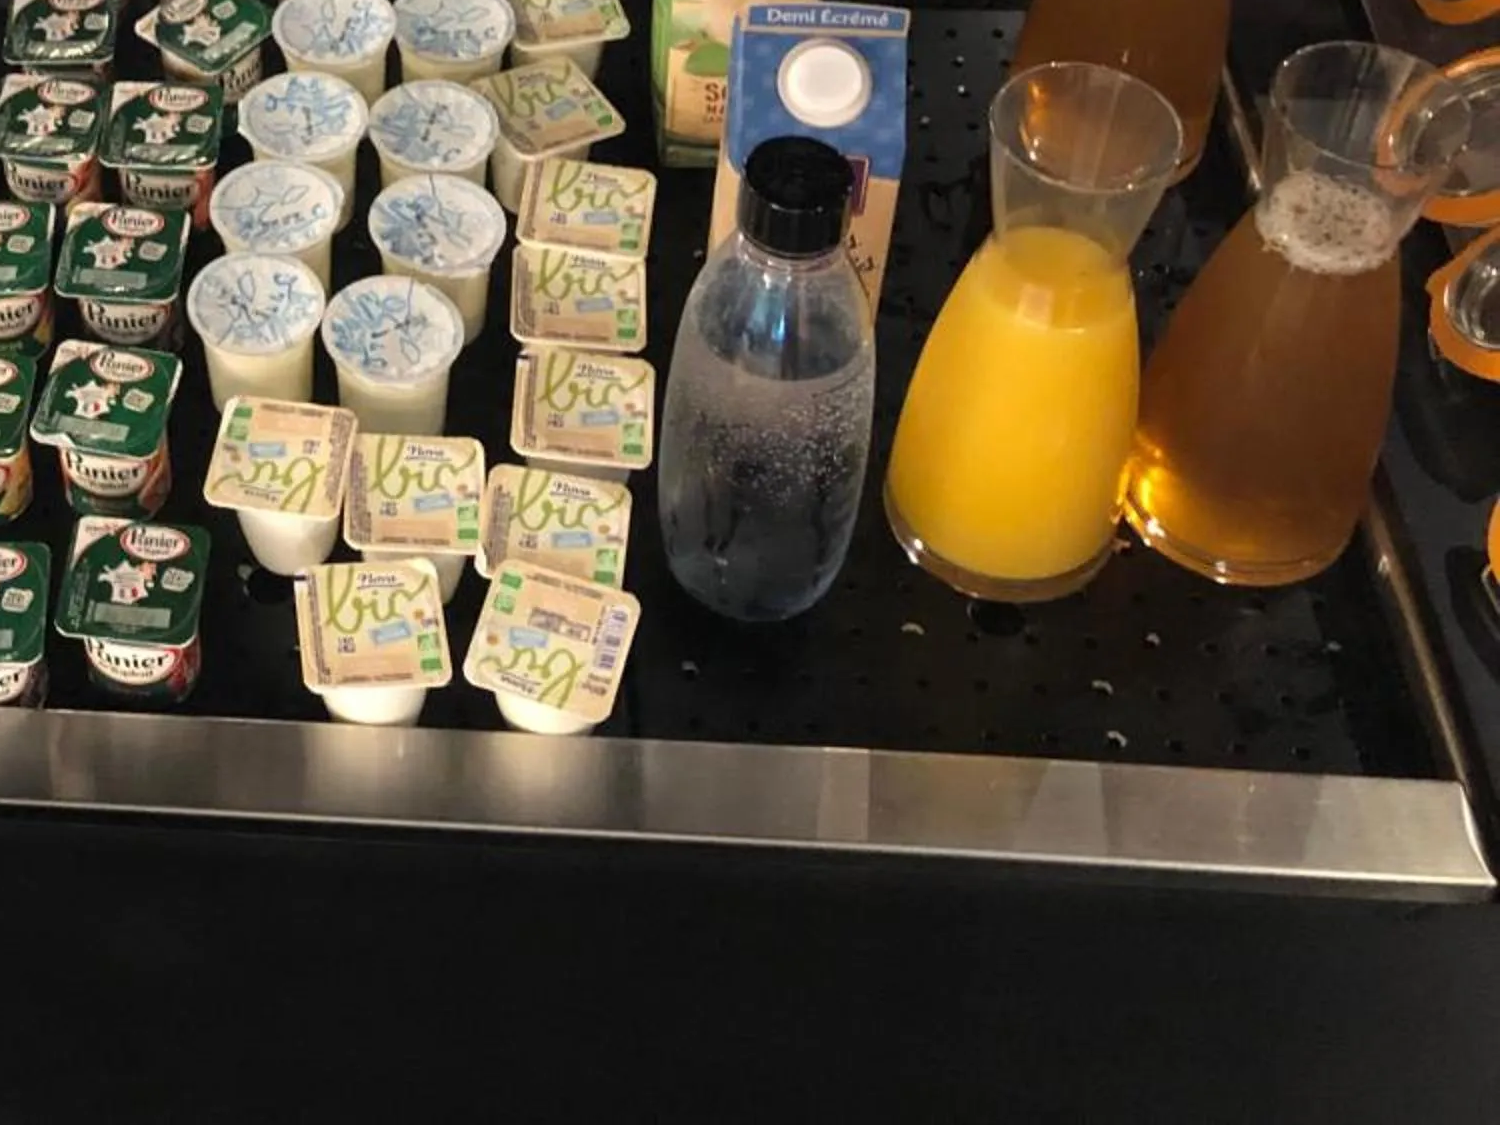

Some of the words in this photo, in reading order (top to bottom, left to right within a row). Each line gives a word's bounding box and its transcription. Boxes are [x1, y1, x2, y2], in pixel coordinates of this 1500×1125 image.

[767, 8, 815, 24] Demi
[88, 302, 159, 330] Panier
[65, 451, 142, 481] Panier
[130, 527, 179, 549] Panier
[85, 633, 168, 669] Panier
